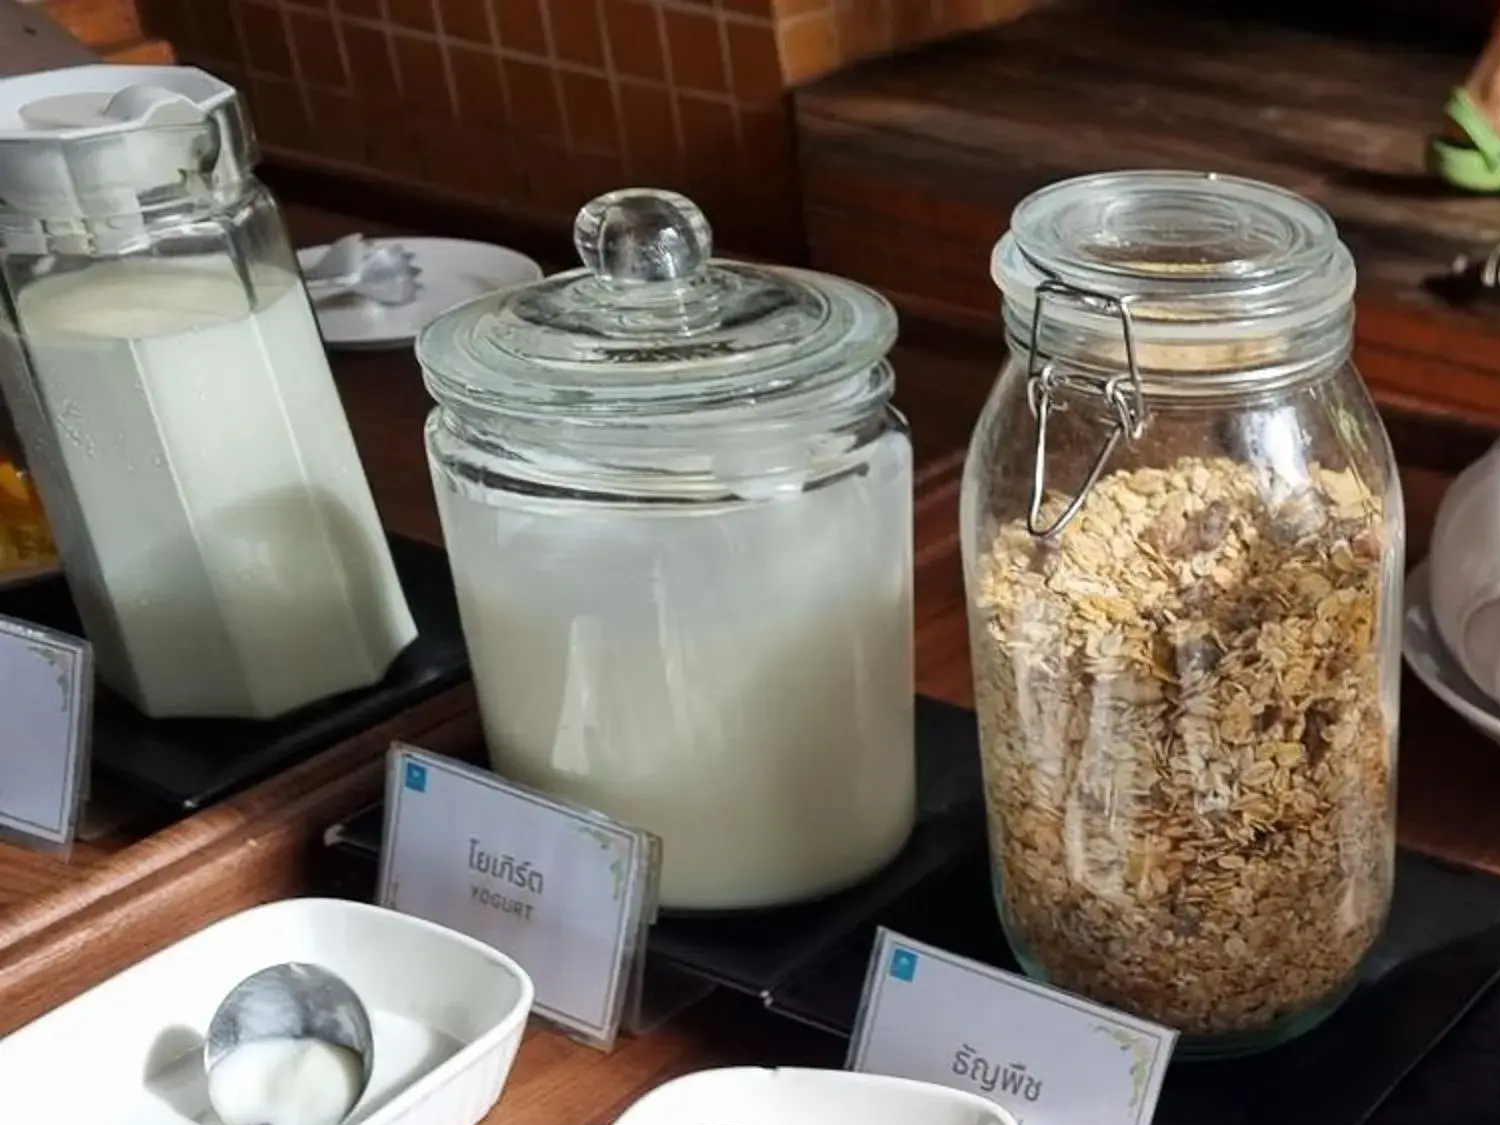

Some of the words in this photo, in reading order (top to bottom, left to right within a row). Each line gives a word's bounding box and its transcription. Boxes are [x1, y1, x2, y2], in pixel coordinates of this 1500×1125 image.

[468, 838, 544, 895] โยเกิร์ต
[470, 883, 534, 920] YOGURT
[952, 1043, 1043, 1102] ธัญพืช
